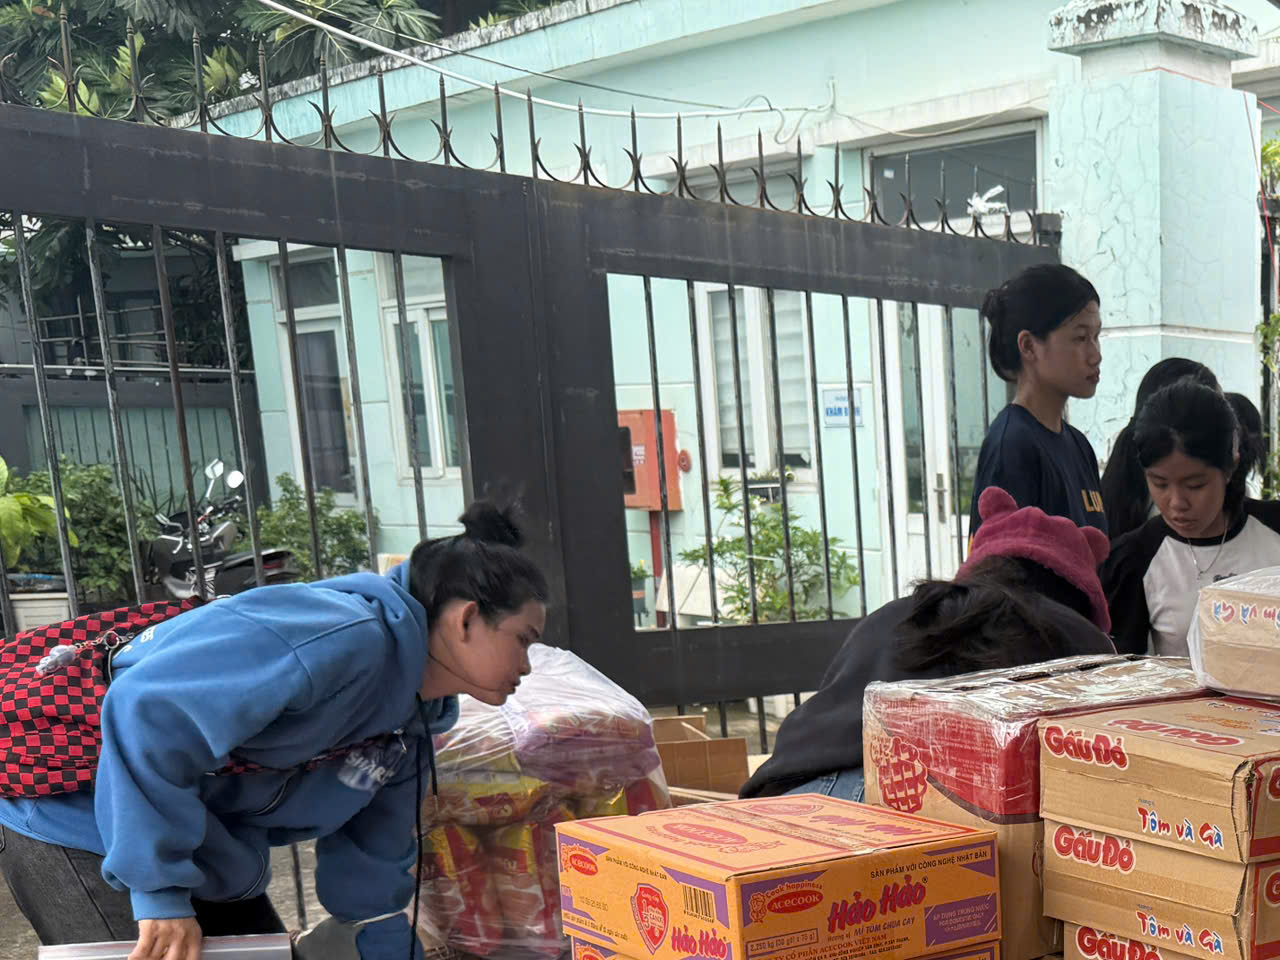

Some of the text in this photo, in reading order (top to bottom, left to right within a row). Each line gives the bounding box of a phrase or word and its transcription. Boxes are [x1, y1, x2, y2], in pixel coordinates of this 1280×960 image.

[1137, 807, 1224, 848] Tôm và Gà
[918, 859, 937, 870] CÔNG
[974, 850, 988, 860] BẢN
[828, 875, 927, 934] Hảo Hảo
[1137, 911, 1224, 955] Tôm và Gà
